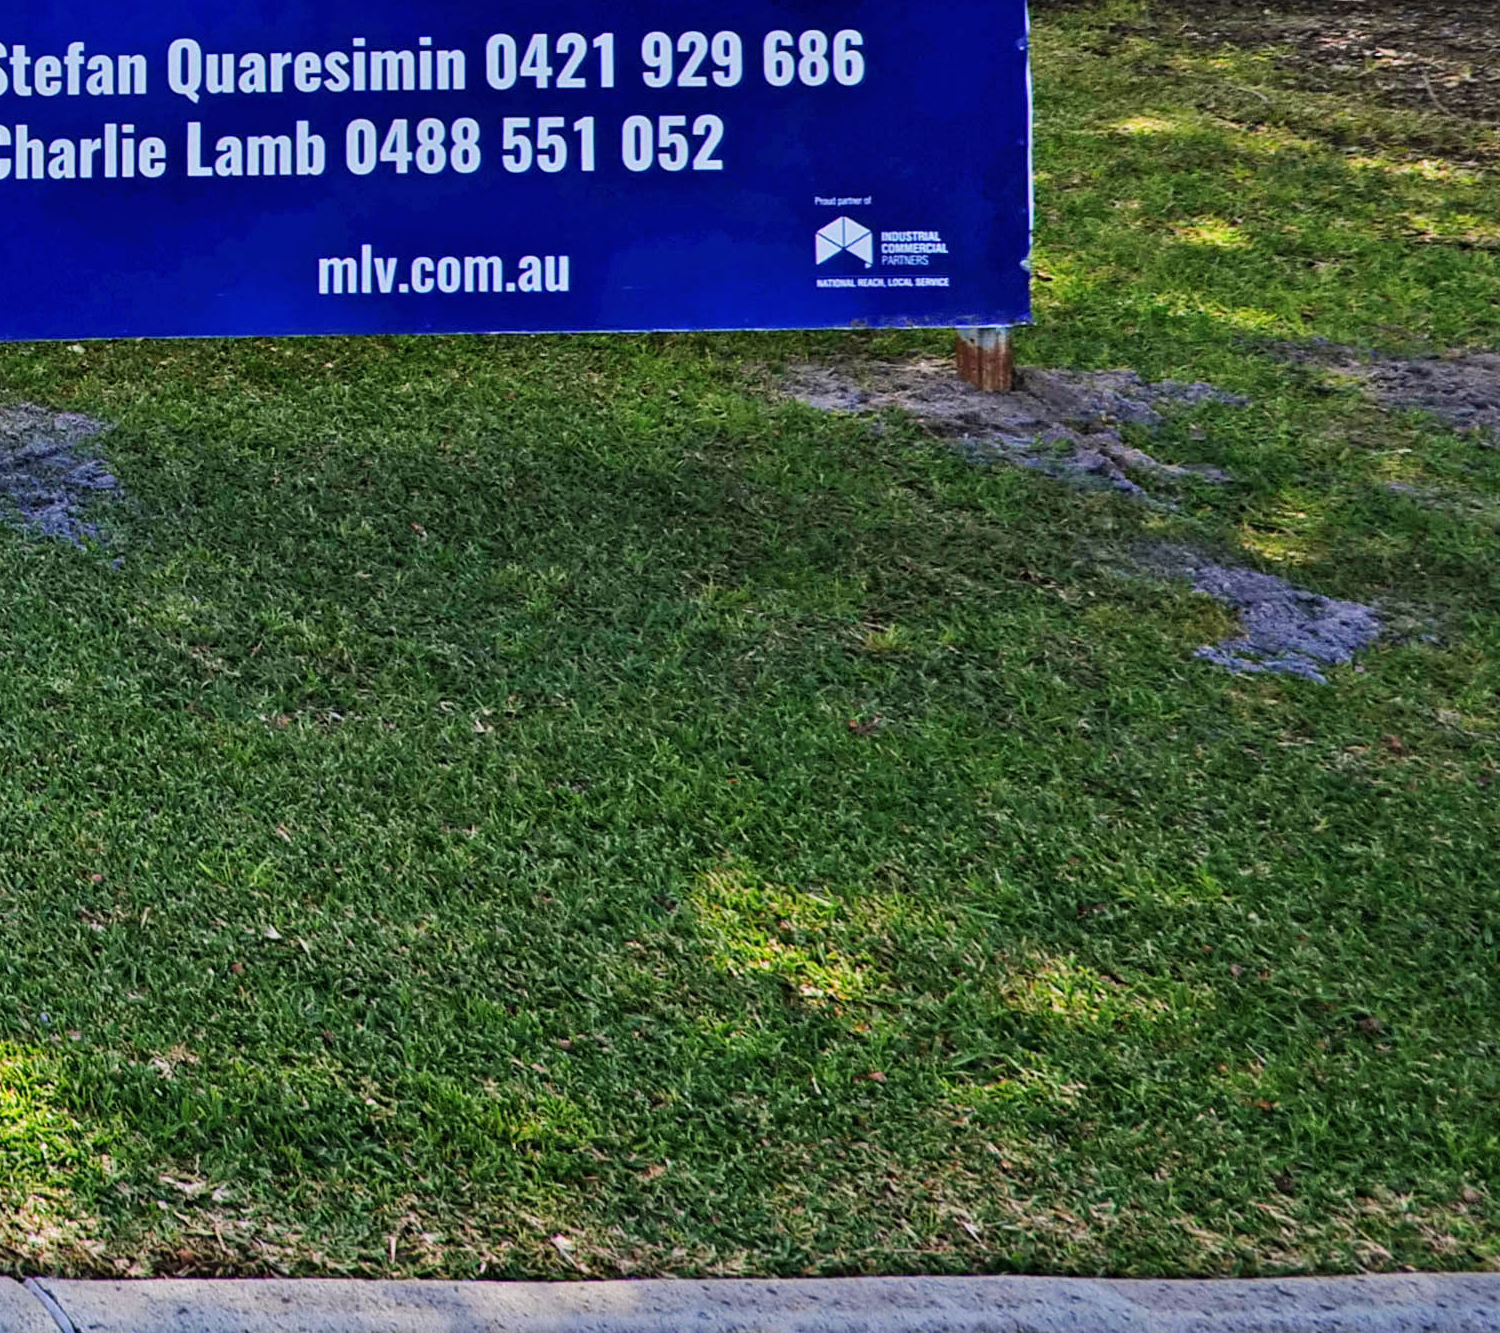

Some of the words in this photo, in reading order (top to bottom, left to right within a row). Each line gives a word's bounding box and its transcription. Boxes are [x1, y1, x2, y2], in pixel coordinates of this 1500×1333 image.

[168, 37, 466, 103] Quaresimin
[486, 33, 614, 90] 0421
[642, 31, 743, 88] 929
[764, 30, 865, 86] 686
[187, 121, 326, 177] Lamb
[346, 118, 481, 175] 0488
[502, 117, 595, 173] 551
[622, 115, 724, 172] 052
[814, 196, 836, 206] Proud
[837, 196, 862, 207] partner
[864, 195, 872, 205] of
[881, 231, 942, 242] INDUSTRIAL
[881, 243, 949, 254] COMMERCIAL
[881, 255, 930, 266] PARTNERS
[319, 244, 569, 295] mlv.com.au
[816, 279, 857, 288] NATIONAL
[888, 278, 913, 287] LOCAL
[915, 278, 950, 287] SERVICE
